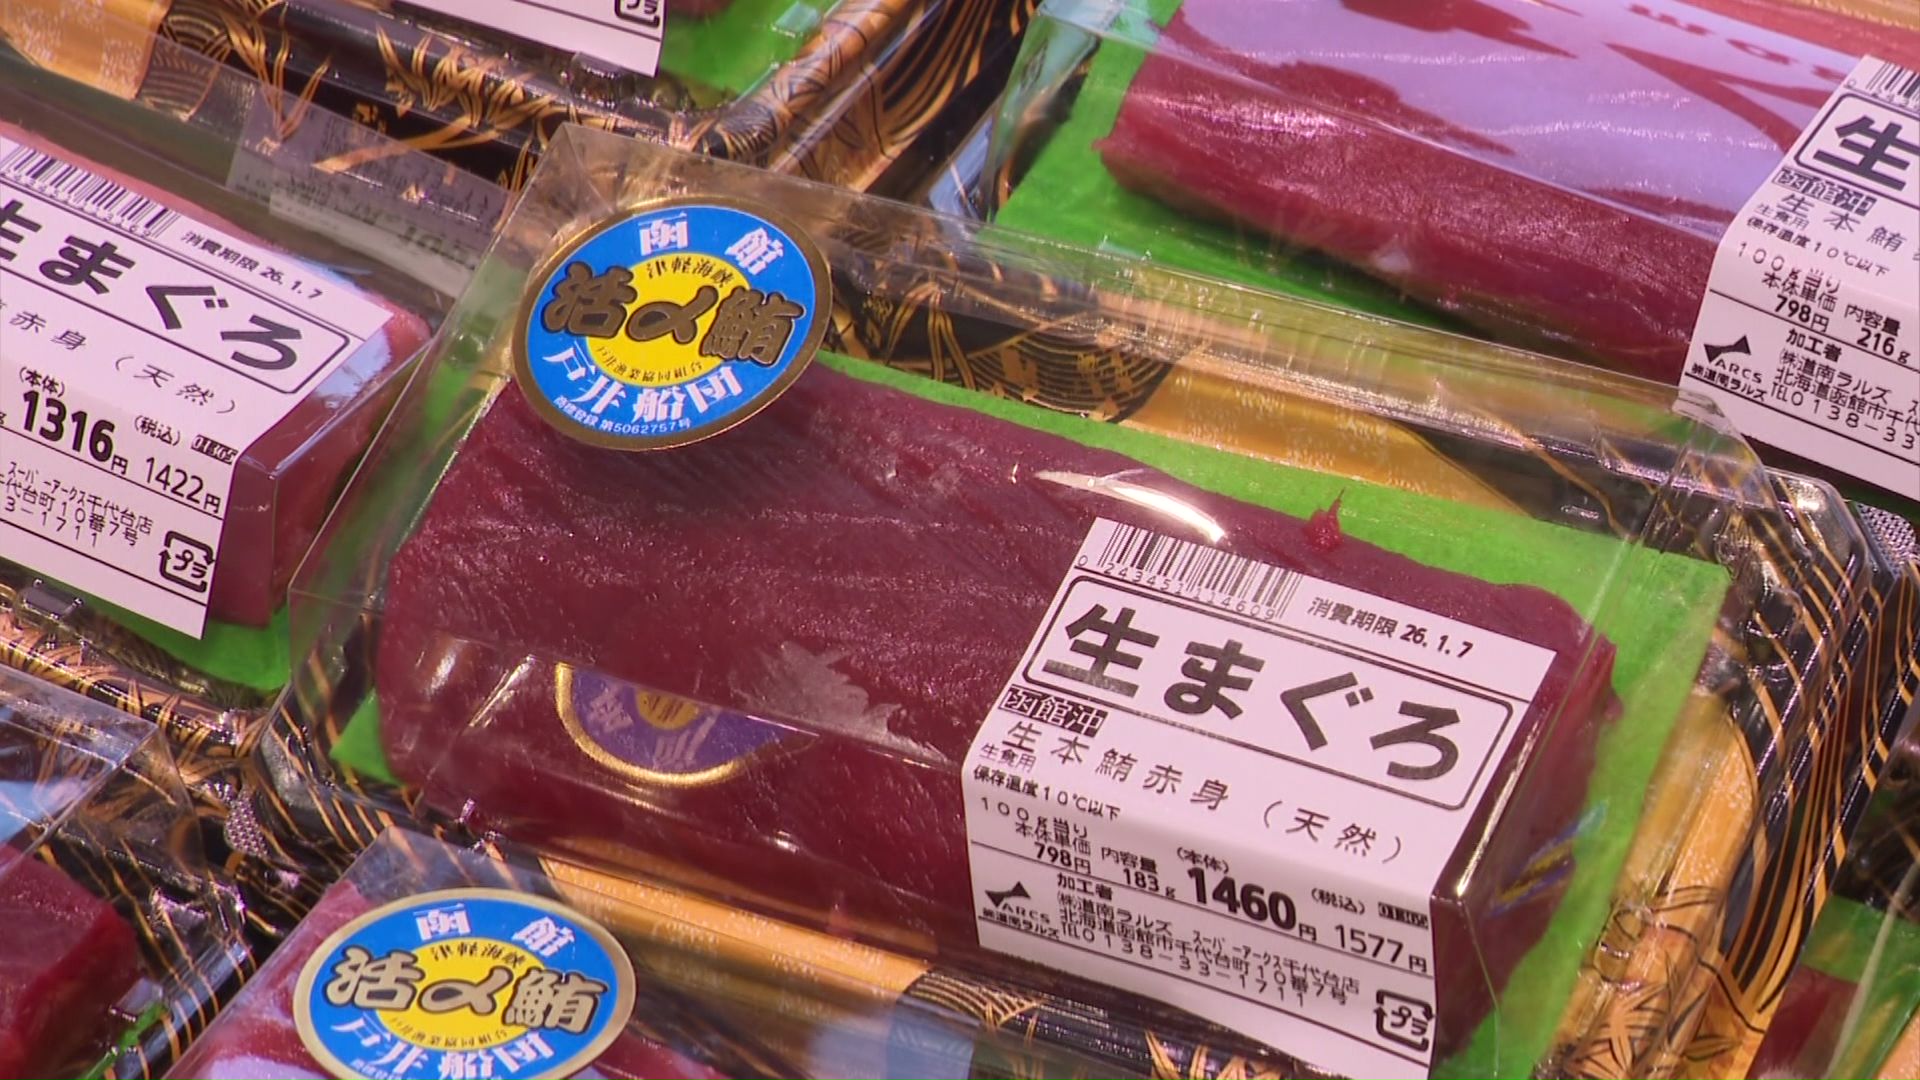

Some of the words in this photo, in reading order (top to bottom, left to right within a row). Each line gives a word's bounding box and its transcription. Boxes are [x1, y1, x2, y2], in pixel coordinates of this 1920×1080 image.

[1754, 203, 1810, 231] 生食用
[1776, 193, 1920, 262] 生本鮪
[181, 231, 260, 273] 消費期限
[646, 255, 735, 289] 津軽海峡
[1762, 271, 1838, 313] 本体単価
[1774, 294, 1830, 333] 798円
[1844, 304, 1900, 337] 内容量
[1786, 328, 1842, 364] 加工者
[19, 366, 66, 398] (本体)
[542, 340, 744, 424] 戸井船団
[1714, 358, 1763, 384] ARCS
[135, 415, 181, 446] (税込)
[0, 474, 139, 547] 代台町10番7号
[173, 550, 208, 580] プラ
[1306, 596, 1399, 639] 消費期限
[1400, 623, 1474, 659] 26.1.7
[1042, 603, 1461, 782] 生まぐろ
[999, 684, 1108, 738] 函館沖
[979, 742, 1037, 774] 生食用
[1015, 821, 1091, 856] 本体単価
[1034, 841, 1091, 875] 798円
[1101, 847, 1158, 875] 内容量
[1176, 846, 1229, 874] (本体)
[1057, 872, 1113, 902] 加工者
[1311, 887, 1366, 916] (税込)
[1001, 902, 1051, 925] ARCS
[1389, 1004, 1429, 1037] プラ
[331, 1010, 555, 1079] 戸井船団
